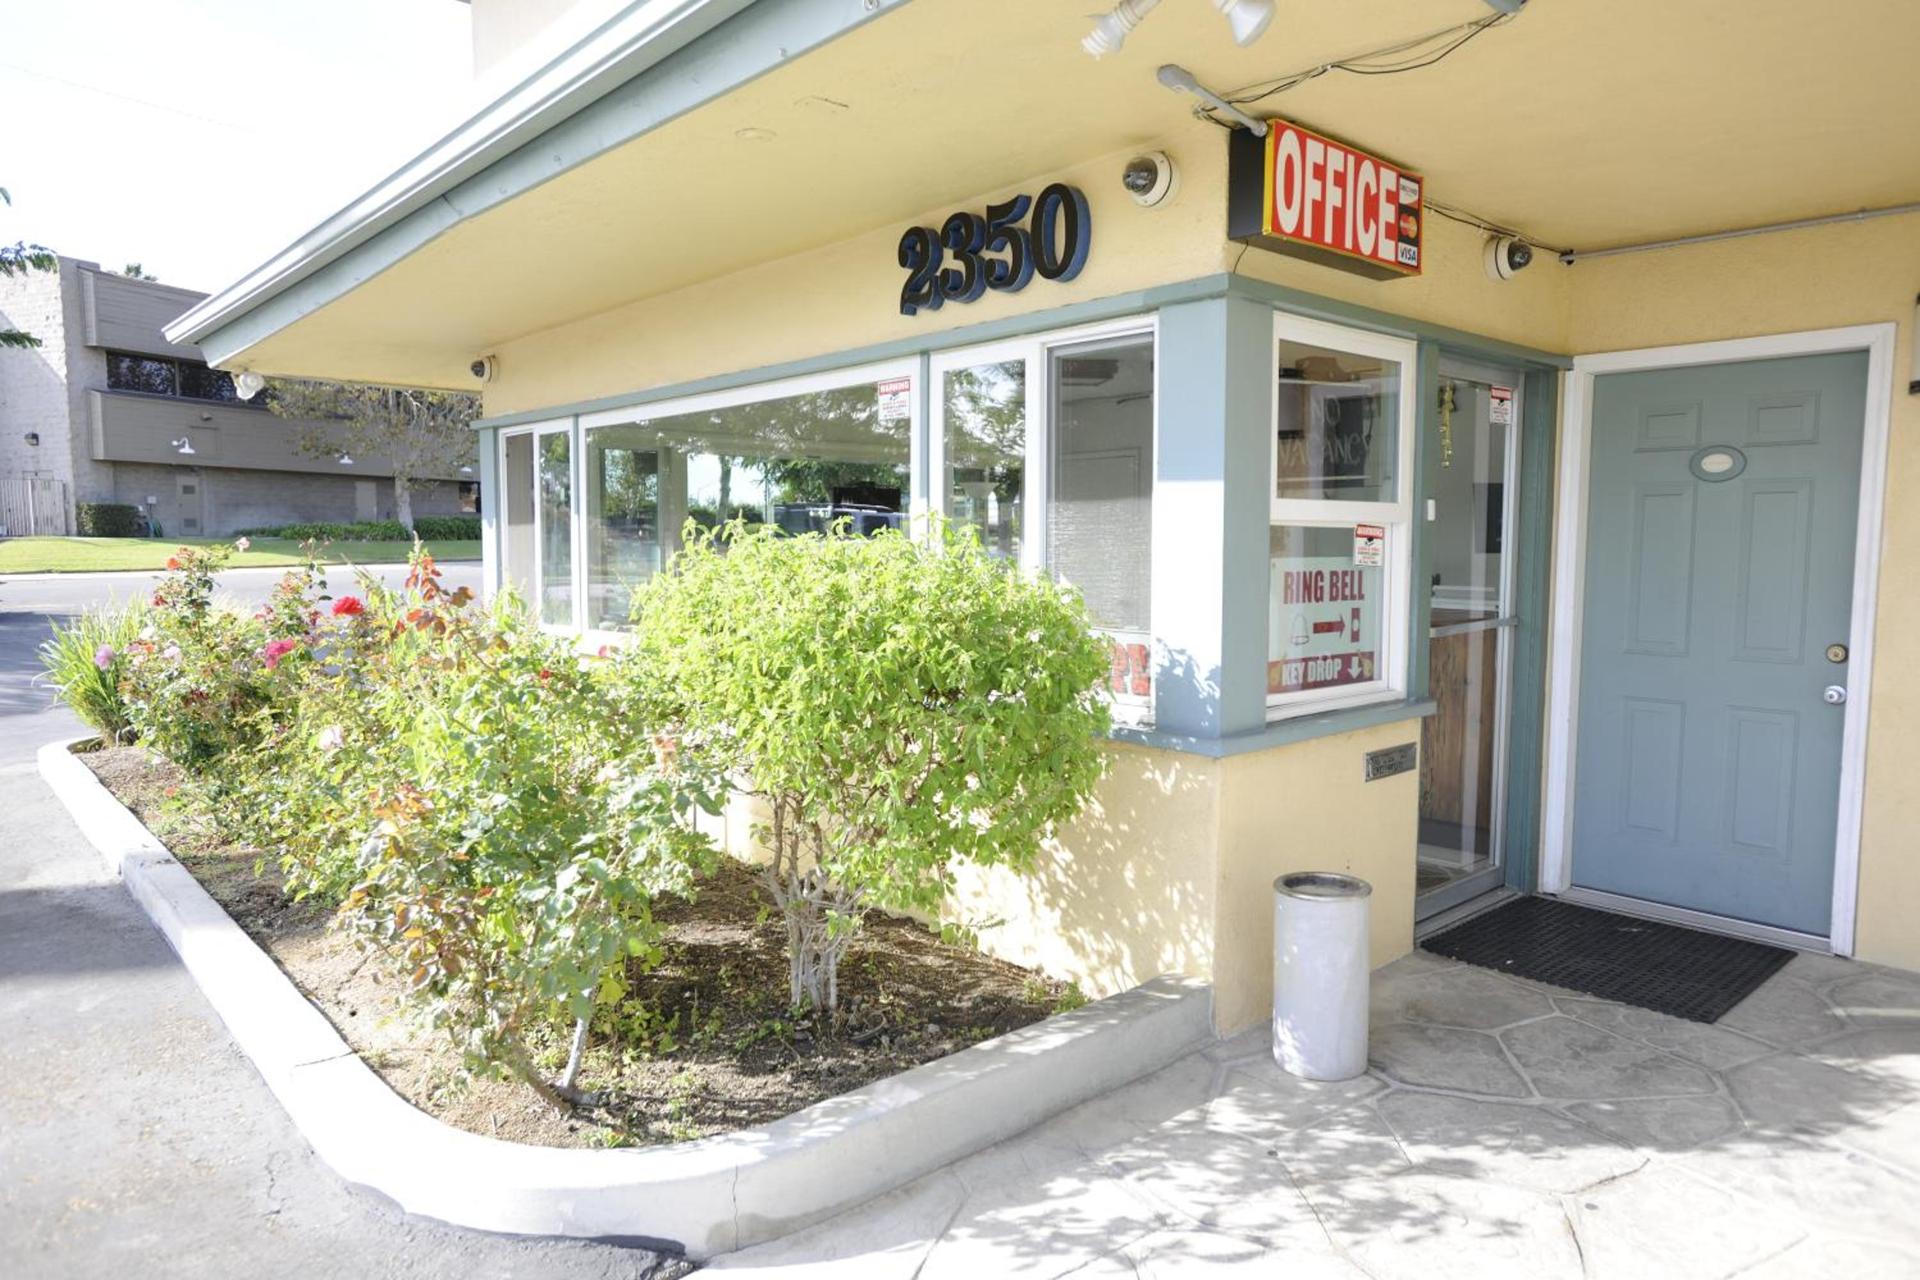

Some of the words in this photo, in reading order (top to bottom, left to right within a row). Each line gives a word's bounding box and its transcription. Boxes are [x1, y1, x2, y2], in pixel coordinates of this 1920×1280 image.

[1276, 129, 1397, 262] OFFICE
[898, 183, 1091, 315] 2350
[1400, 248, 1416, 262] VISA
[1284, 570, 1324, 604] RING
[1329, 570, 1364, 601] BELL
[1282, 661, 1306, 687] KEY
[1308, 658, 1341, 683] DROP
